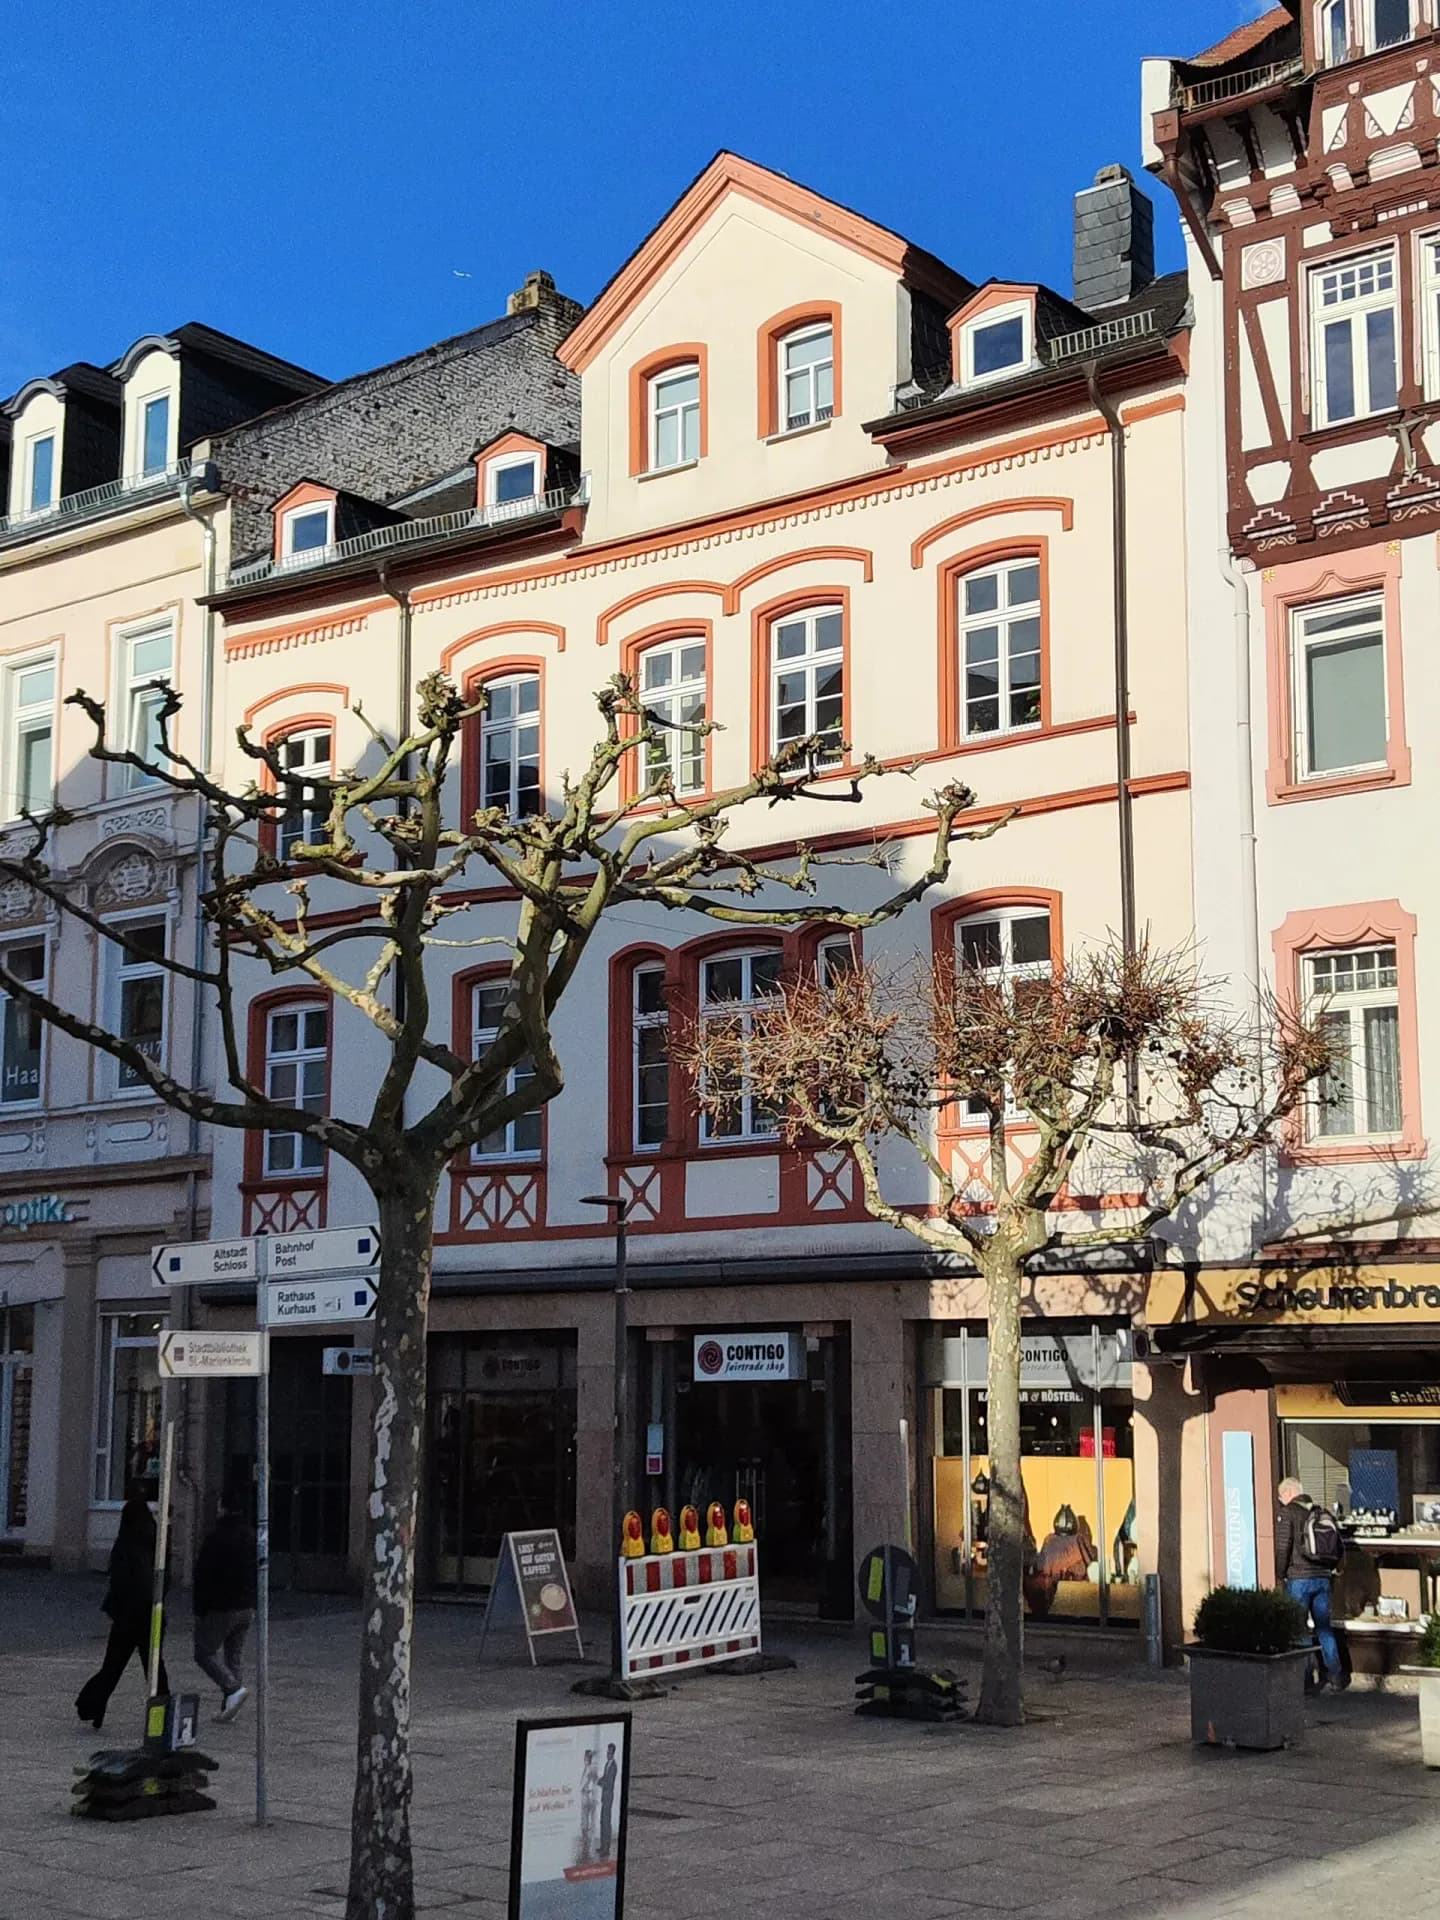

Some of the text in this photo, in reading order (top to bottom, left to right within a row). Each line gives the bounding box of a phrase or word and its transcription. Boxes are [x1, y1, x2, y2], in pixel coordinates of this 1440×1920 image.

[6, 1066, 39, 1087] Haa
[213, 1247, 248, 1260] Altstadt
[275, 1239, 316, 1255] Bahnhof
[213, 1260, 248, 1272] Schloss
[275, 1256, 296, 1267] Post
[278, 1291, 315, 1302] Rathaus
[278, 1304, 316, 1315] Kurhaus
[726, 1344, 785, 1361] CONTIGO
[1019, 1349, 1069, 1362] CONTIGO
[725, 1359, 785, 1373] fairtrade shop
